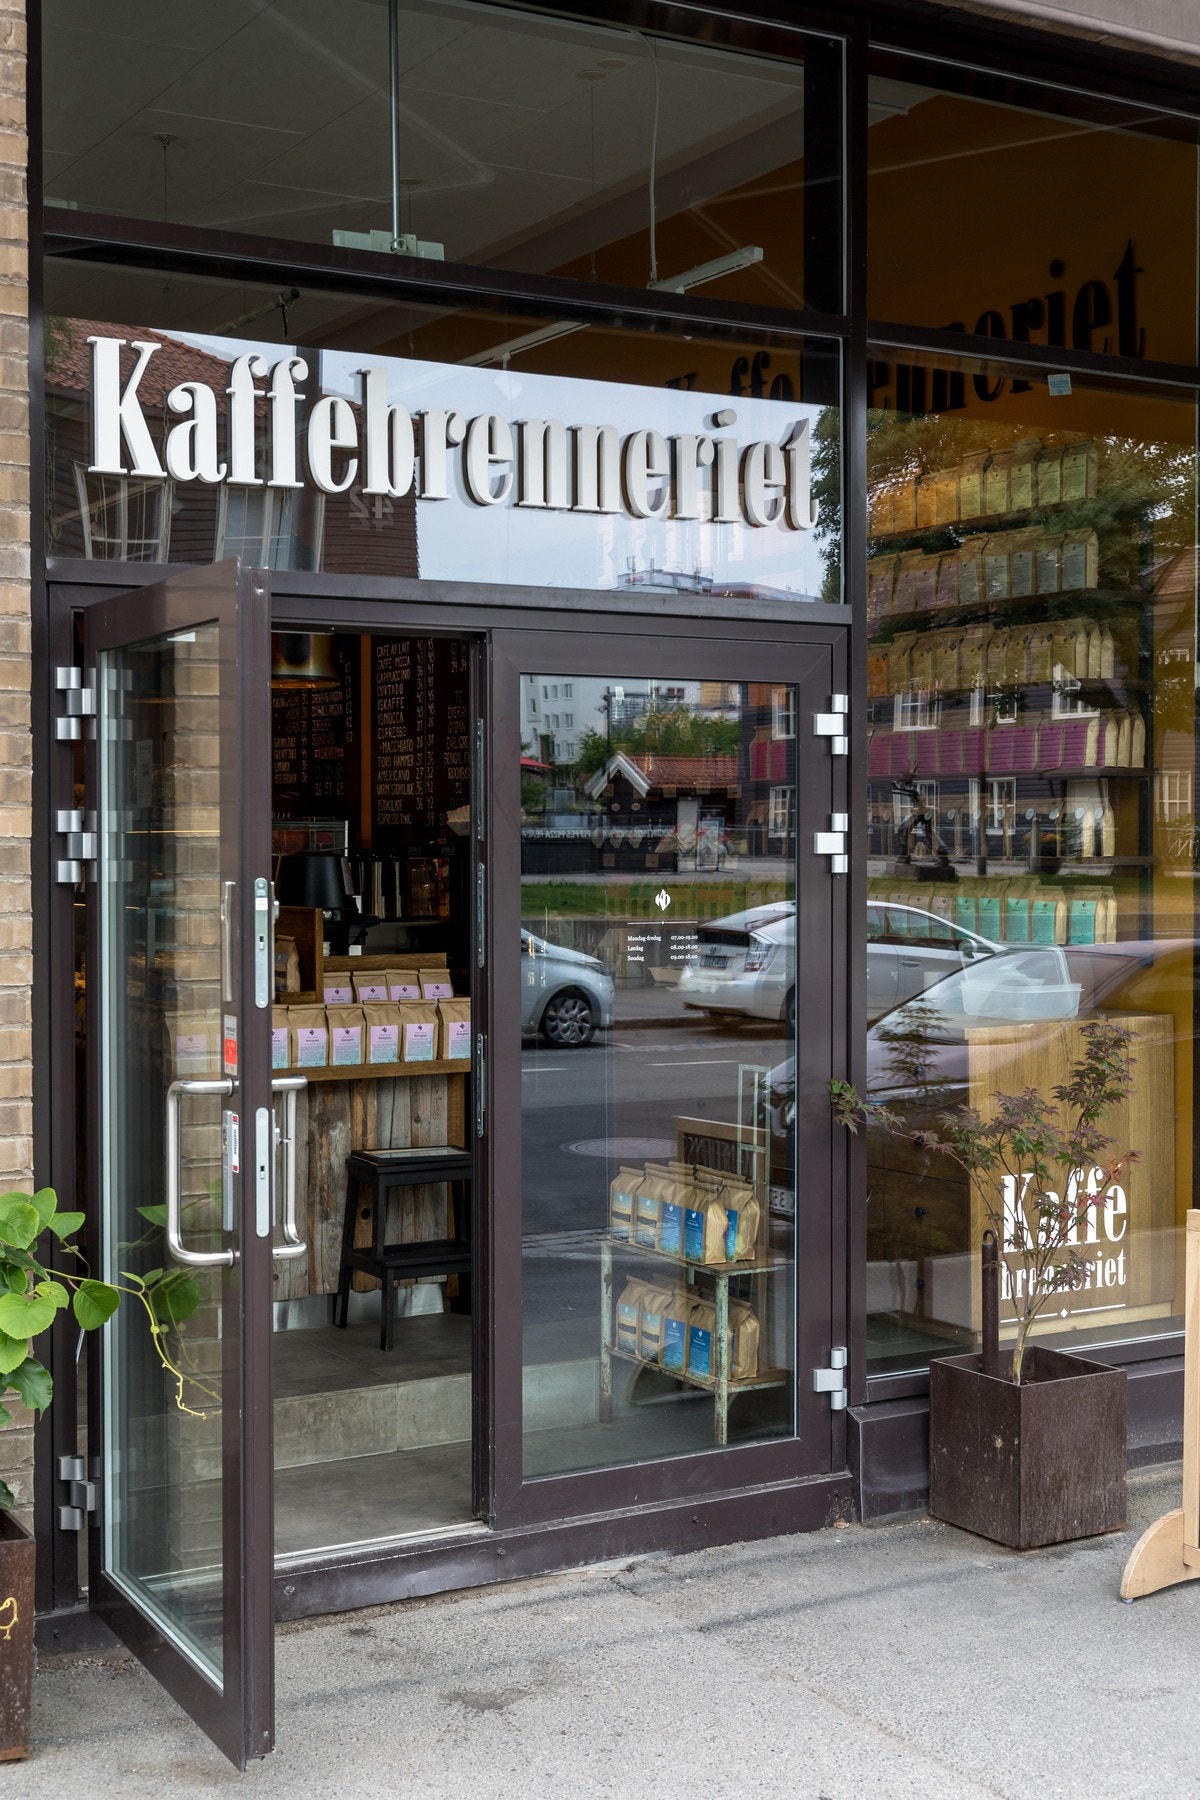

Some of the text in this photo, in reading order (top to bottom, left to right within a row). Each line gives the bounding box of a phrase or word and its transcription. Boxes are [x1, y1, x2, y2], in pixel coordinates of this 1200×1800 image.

[88, 336, 819, 530] Kaffebrenneriet
[378, 697, 404, 712] ISKAFFE
[378, 726, 407, 740] ESPRESSO
[378, 769, 410, 782] AMERICANO
